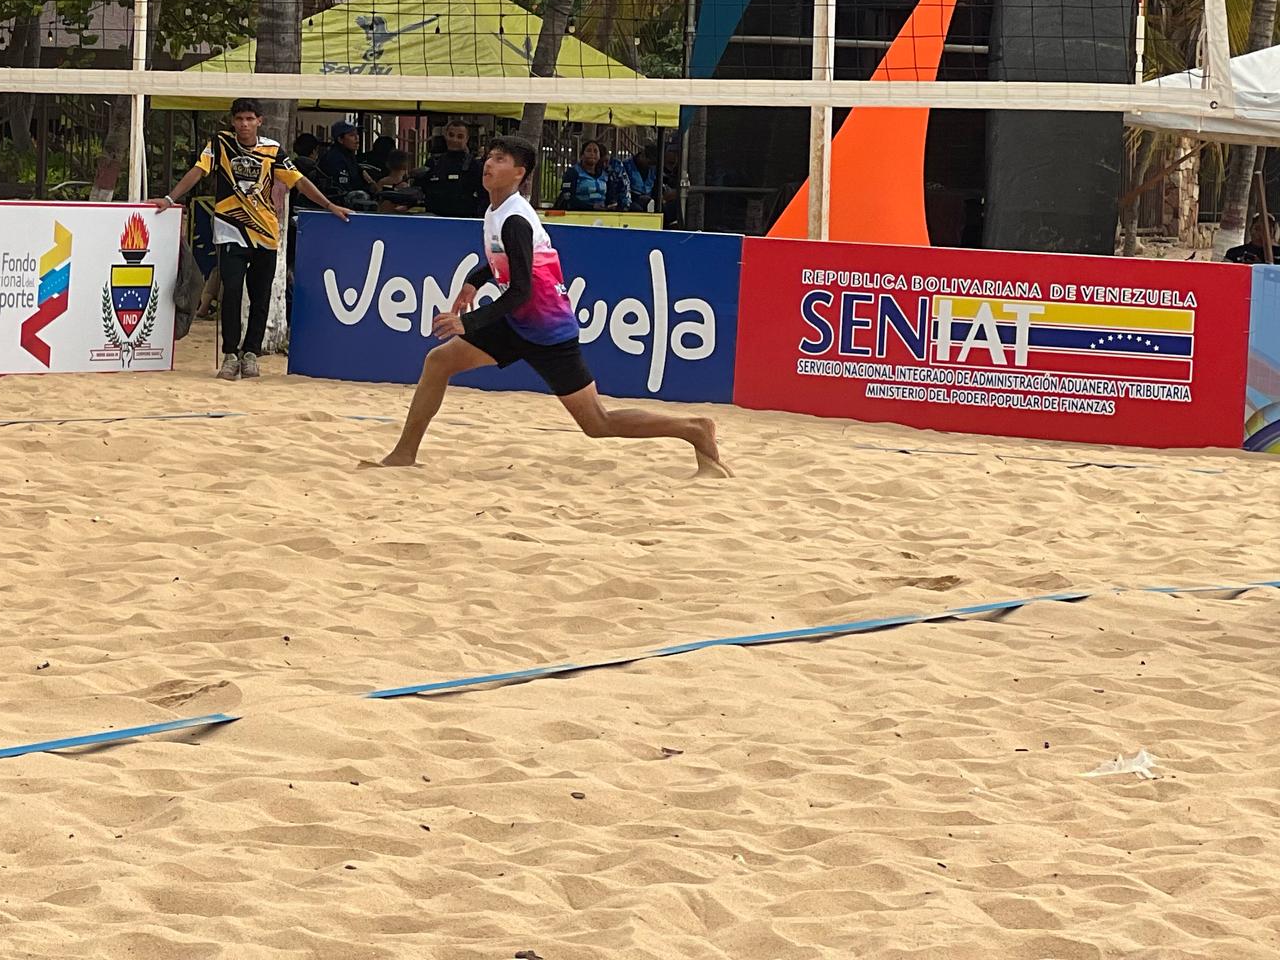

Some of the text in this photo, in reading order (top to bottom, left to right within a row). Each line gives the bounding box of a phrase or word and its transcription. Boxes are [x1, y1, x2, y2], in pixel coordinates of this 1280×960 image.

[1, 252, 37, 272] Fondo
[802, 269, 1198, 308] REPUBLICA BOLIVARIANA DE VENEZUELA
[122, 314, 138, 325] IND
[799, 290, 1046, 367] SENIAT
[797, 358, 1192, 402] SERVICIO NACIONAL INTEGRADO DE ADMINISTRACIÓN ADUANERA Y TRIBUTARIA
[865, 383, 1115, 416] MINISTERIO DEL PODER POPULAR DE FINANZAS
